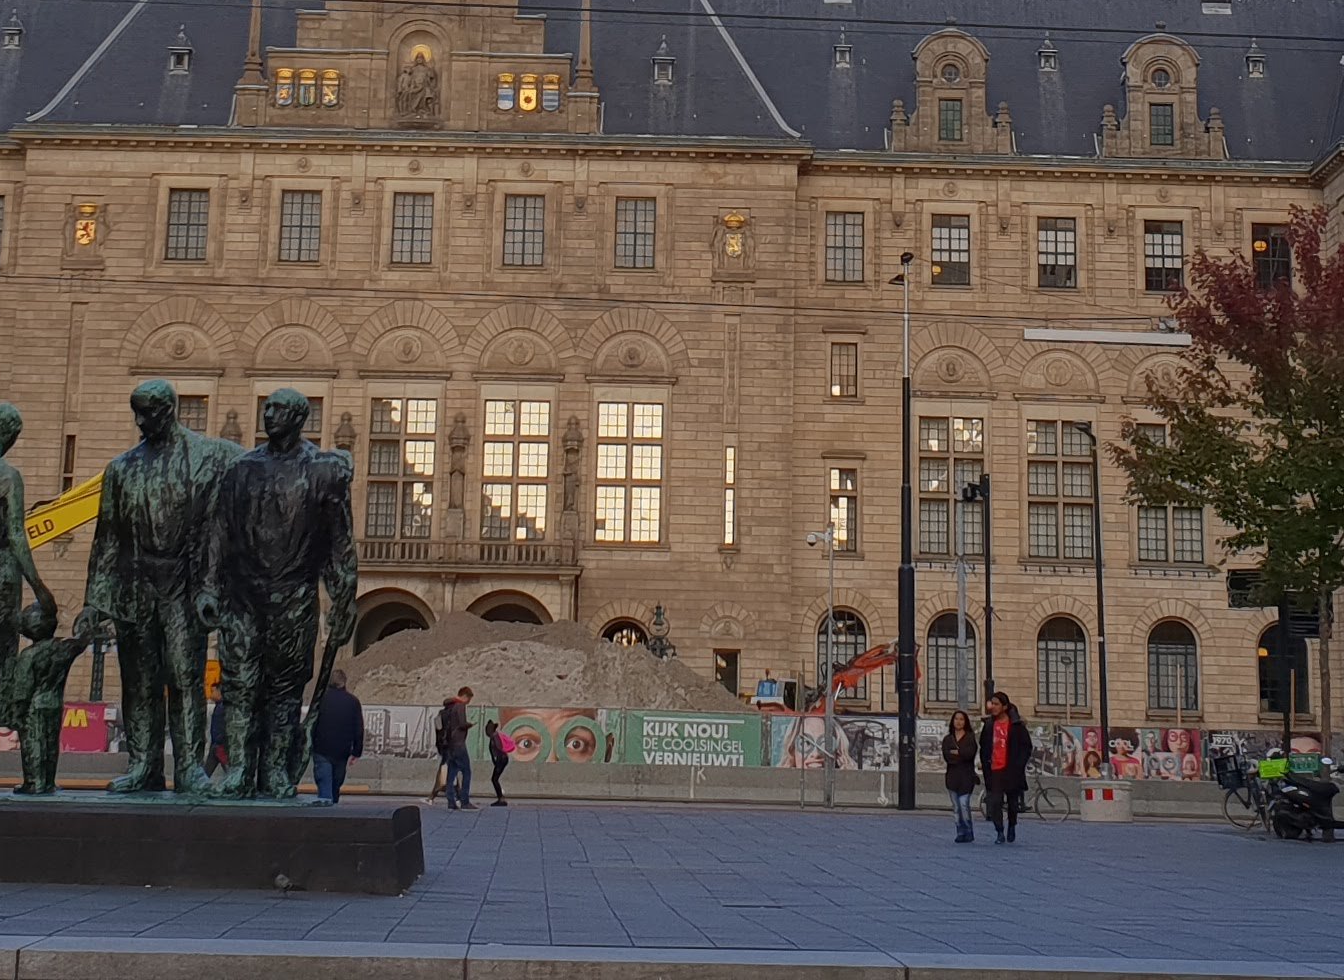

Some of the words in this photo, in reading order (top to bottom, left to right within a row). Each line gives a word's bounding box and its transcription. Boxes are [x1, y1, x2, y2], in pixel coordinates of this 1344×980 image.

[642, 721, 679, 737] KIJK
[642, 737, 658, 750] DE
[662, 738, 744, 753] COOLSINGEL
